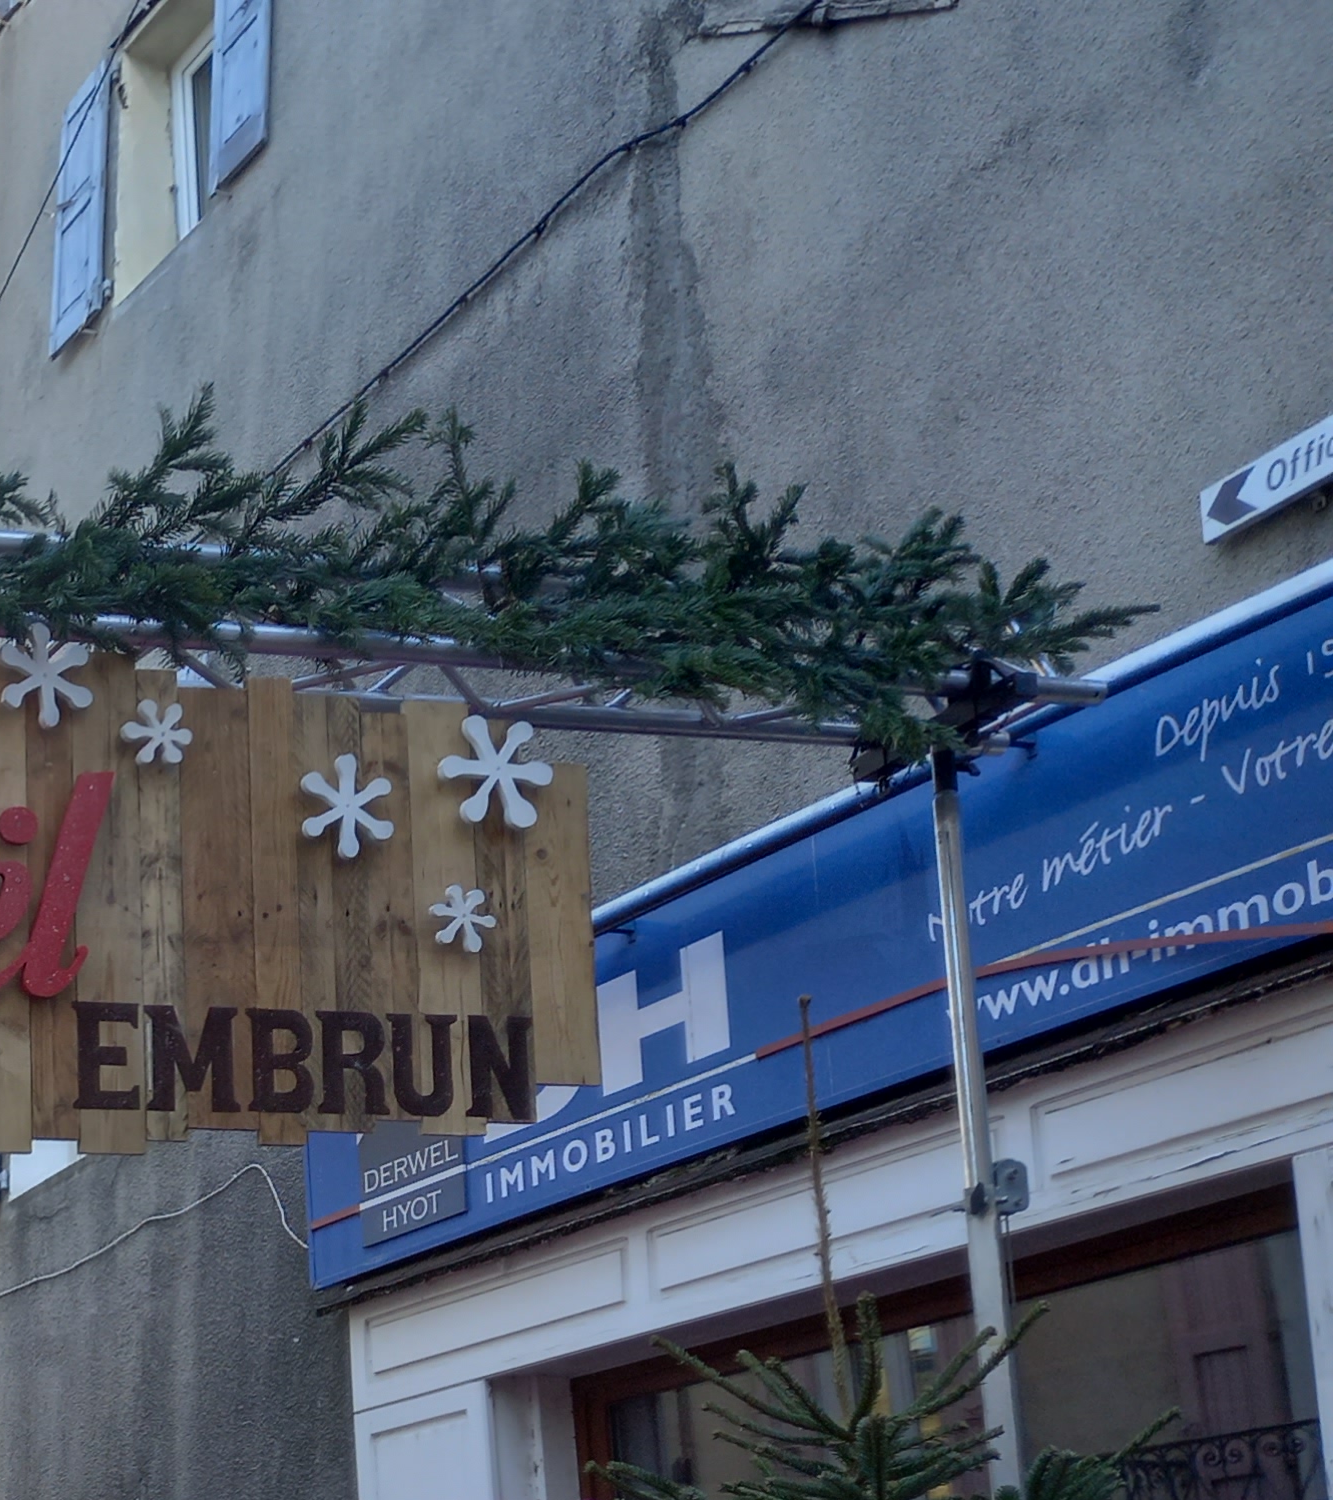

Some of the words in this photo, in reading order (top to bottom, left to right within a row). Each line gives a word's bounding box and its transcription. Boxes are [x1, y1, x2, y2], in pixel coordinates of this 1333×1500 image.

[1155, 658, 1280, 762] Depuis
[1042, 805, 1172, 892] métier
[1221, 719, 1333, 794] Votre
[75, 1002, 533, 1121] EMBRUN
[363, 1140, 459, 1194] DERWEL
[485, 1083, 737, 1202] IMMOBILIER
[382, 1190, 443, 1232] HYOT
